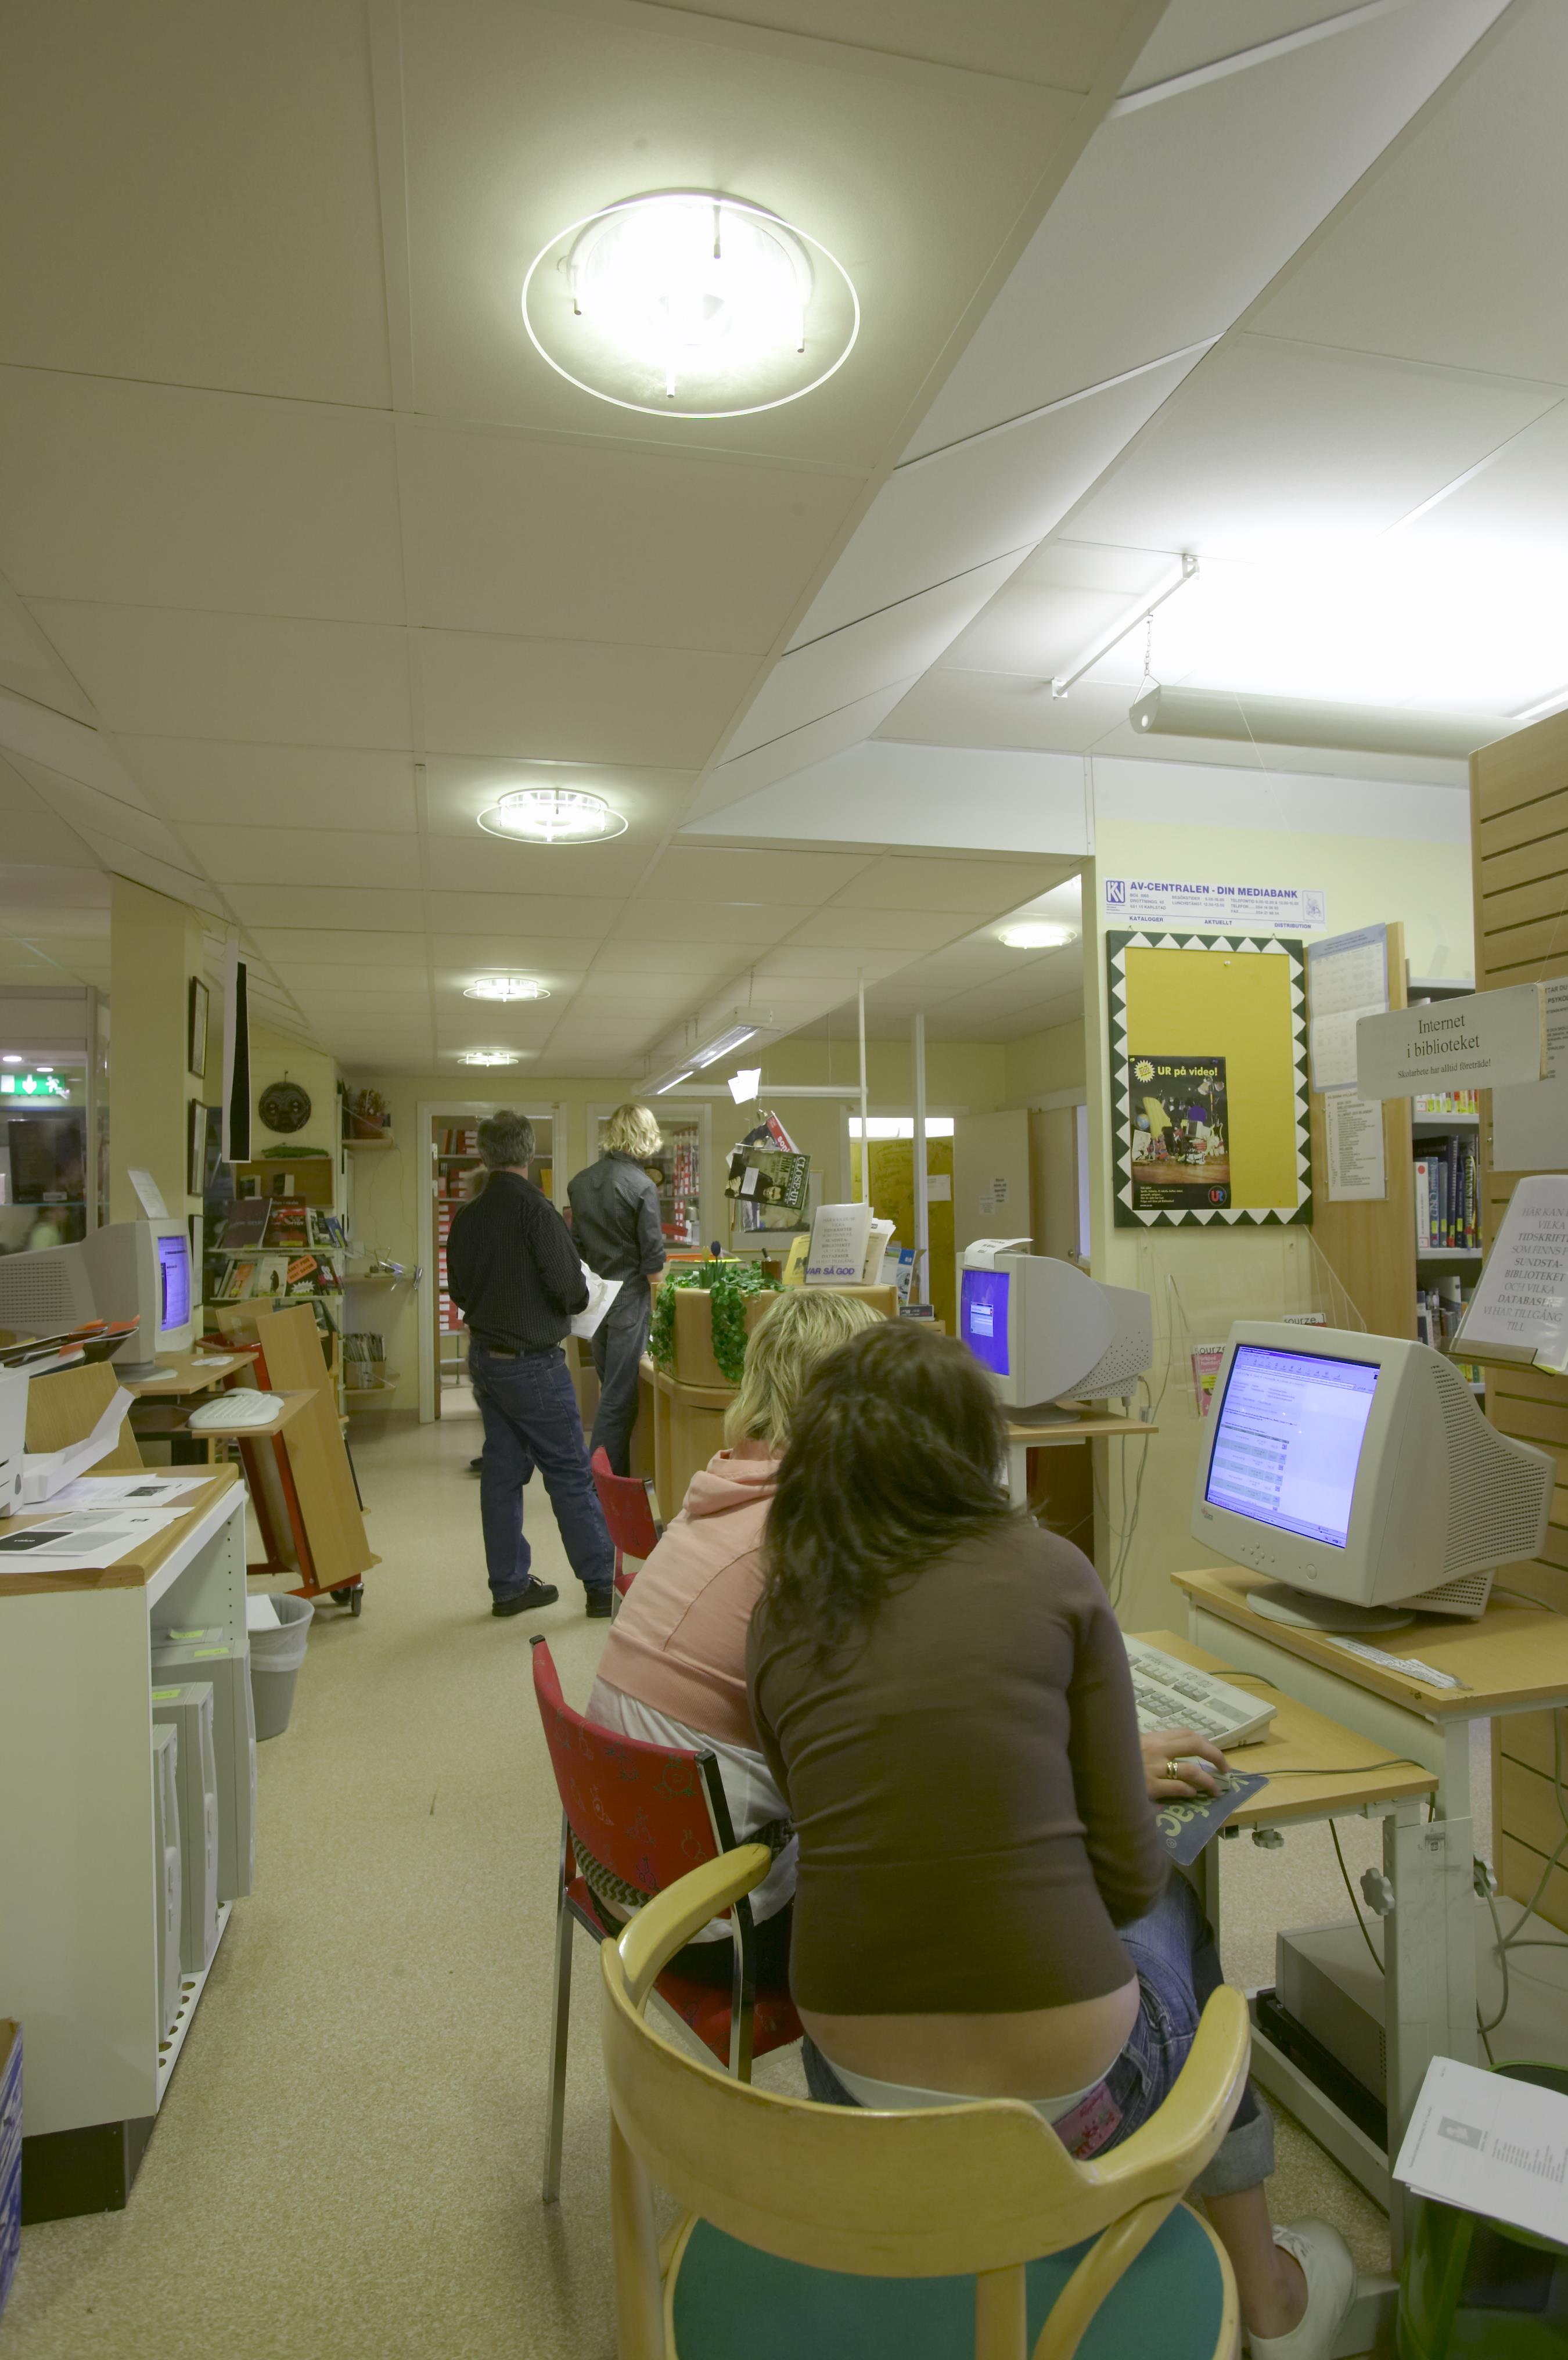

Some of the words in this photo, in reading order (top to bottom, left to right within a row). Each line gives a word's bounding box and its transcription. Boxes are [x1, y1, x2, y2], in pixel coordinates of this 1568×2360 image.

[1130, 882, 1209, 894] AV-CENTRALEN
[1217, 886, 1235, 895] DIN
[1238, 887, 1297, 898] MEDIABANK
[1418, 1014, 1466, 1035] Internet
[1415, 1035, 1480, 1057] biblioteket
[1157, 1066, 1171, 1075] UR
[1174, 1065, 1186, 1077] på
[1188, 1066, 1218, 1076] video!
[1397, 1066, 1429, 1079] Skolarbete
[1430, 1065, 1440, 1074] har
[1441, 1062, 1458, 1073] alltid
[1459, 1058, 1491, 1071] företräde!
[779, 1157, 792, 1173] HIM
[789, 1156, 806, 1205] CLOSE-UP
[1522, 1207, 1542, 1217] HÄR
[1542, 1208, 1565, 1217] KAN
[1538, 1221, 1565, 1229] VILKA
[1511, 1244, 1531, 1254] SOM
[1532, 1246, 1561, 1255] FINNS
[1515, 1258, 1563, 1268] SUNDSTA-
[823, 1266, 835, 1275] SÅ
[1505, 1269, 1566, 1282] BIBLIOTEKET
[1504, 1282, 1525, 1291] OCH
[1527, 1284, 1555, 1294] VILKA
[1483, 1306, 1493, 1315] VI
[1493, 1307, 1513, 1316] HAR
[1514, 1308, 1563, 1322] TILLGÅNG
[1506, 1321, 1524, 1332] TILL
